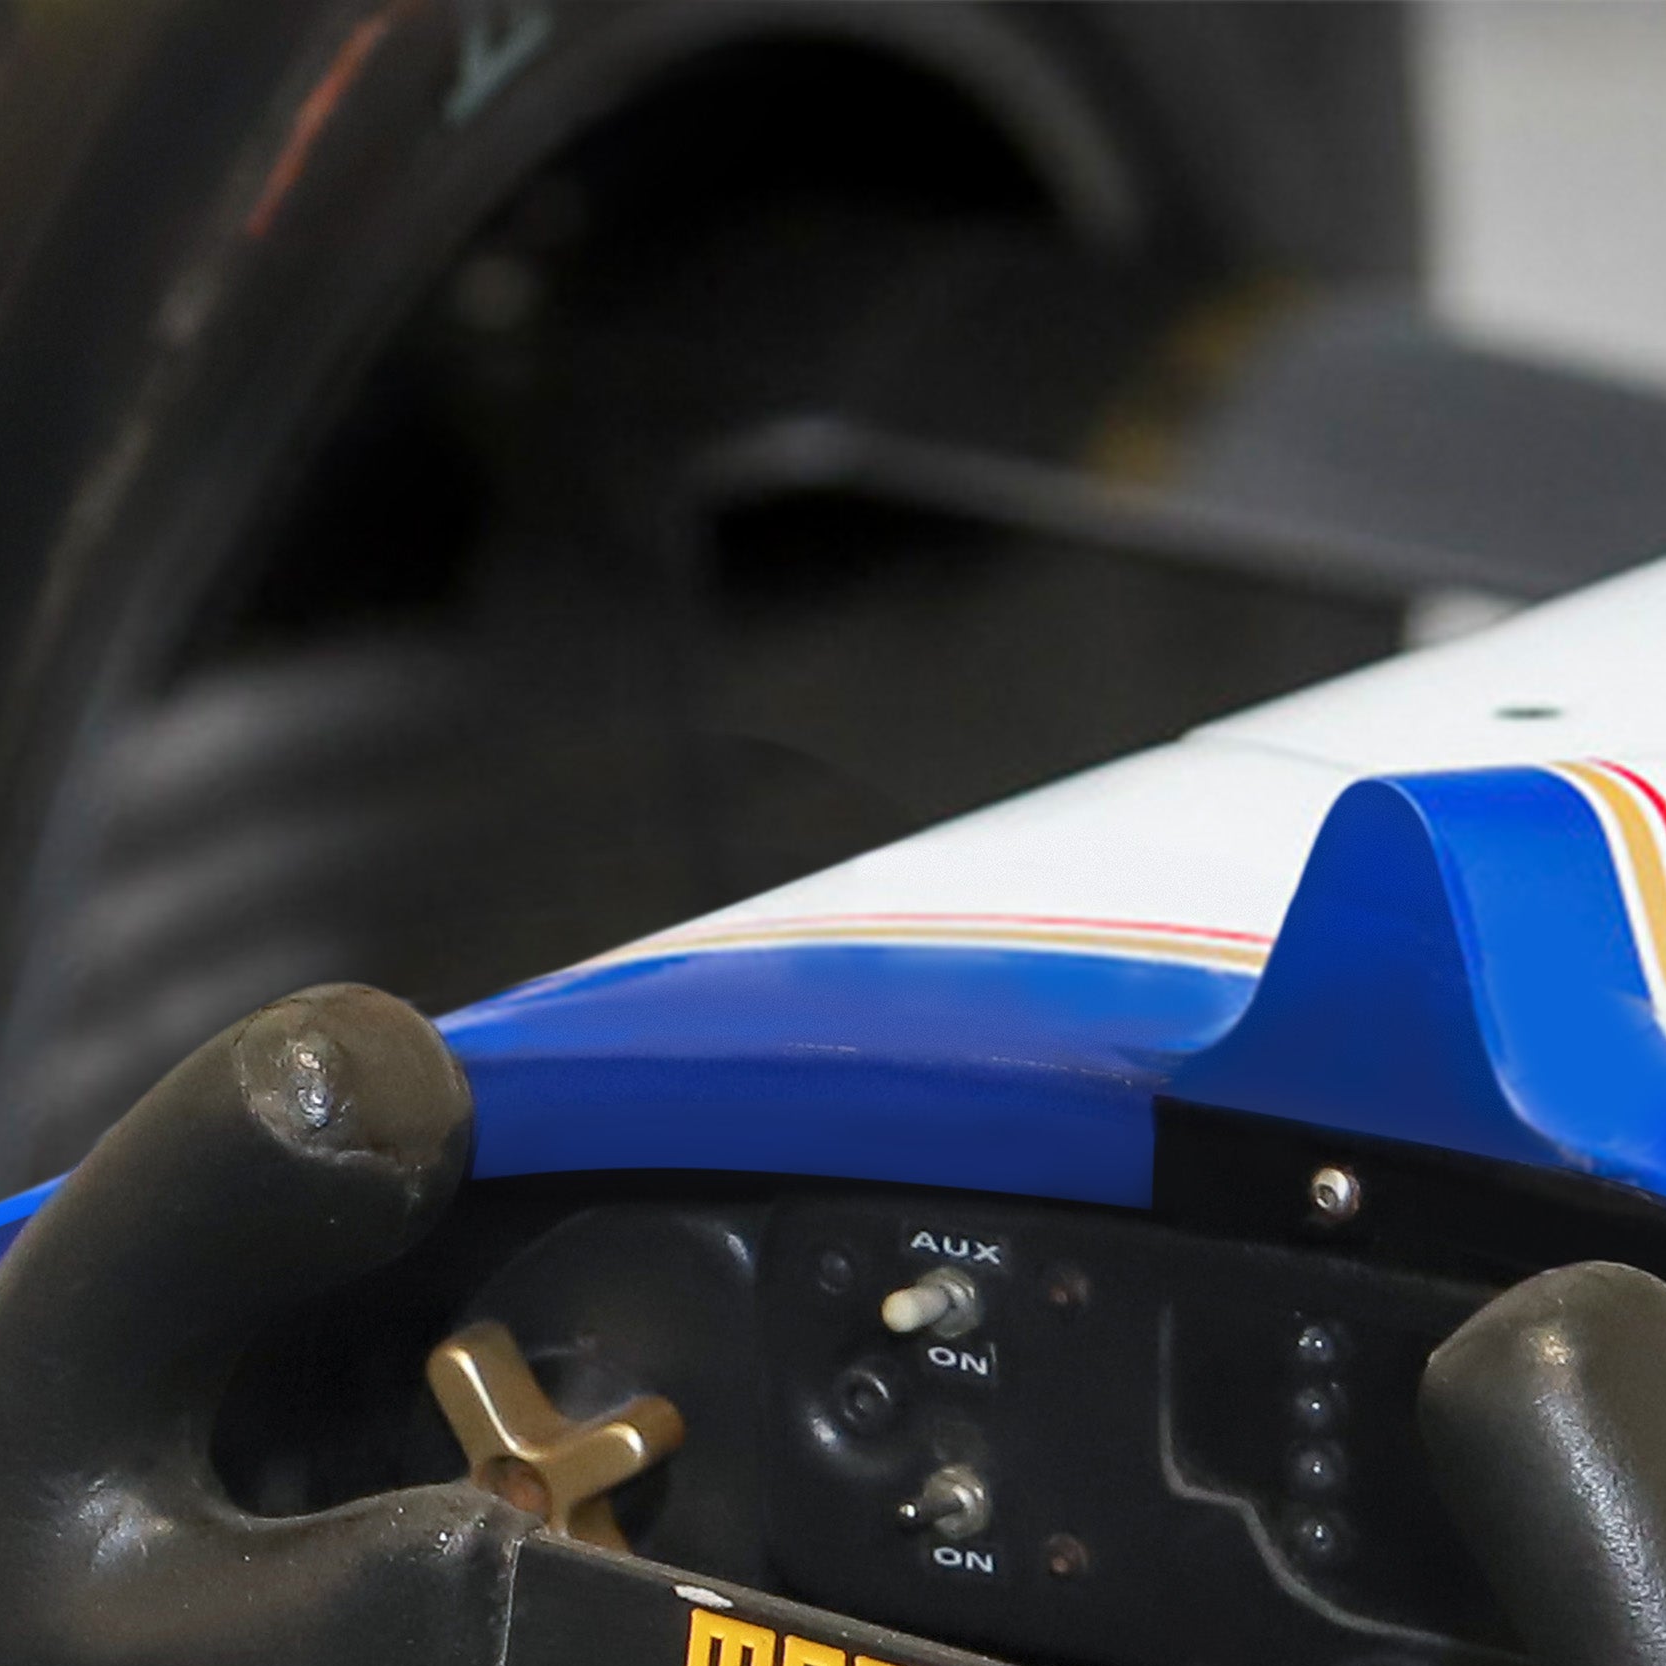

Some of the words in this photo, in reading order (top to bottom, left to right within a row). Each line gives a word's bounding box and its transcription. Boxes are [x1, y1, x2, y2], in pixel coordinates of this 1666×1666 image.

[910, 1230, 1001, 1265] AUX
[927, 1345, 989, 1375] ON
[934, 1546, 994, 1574] ON
